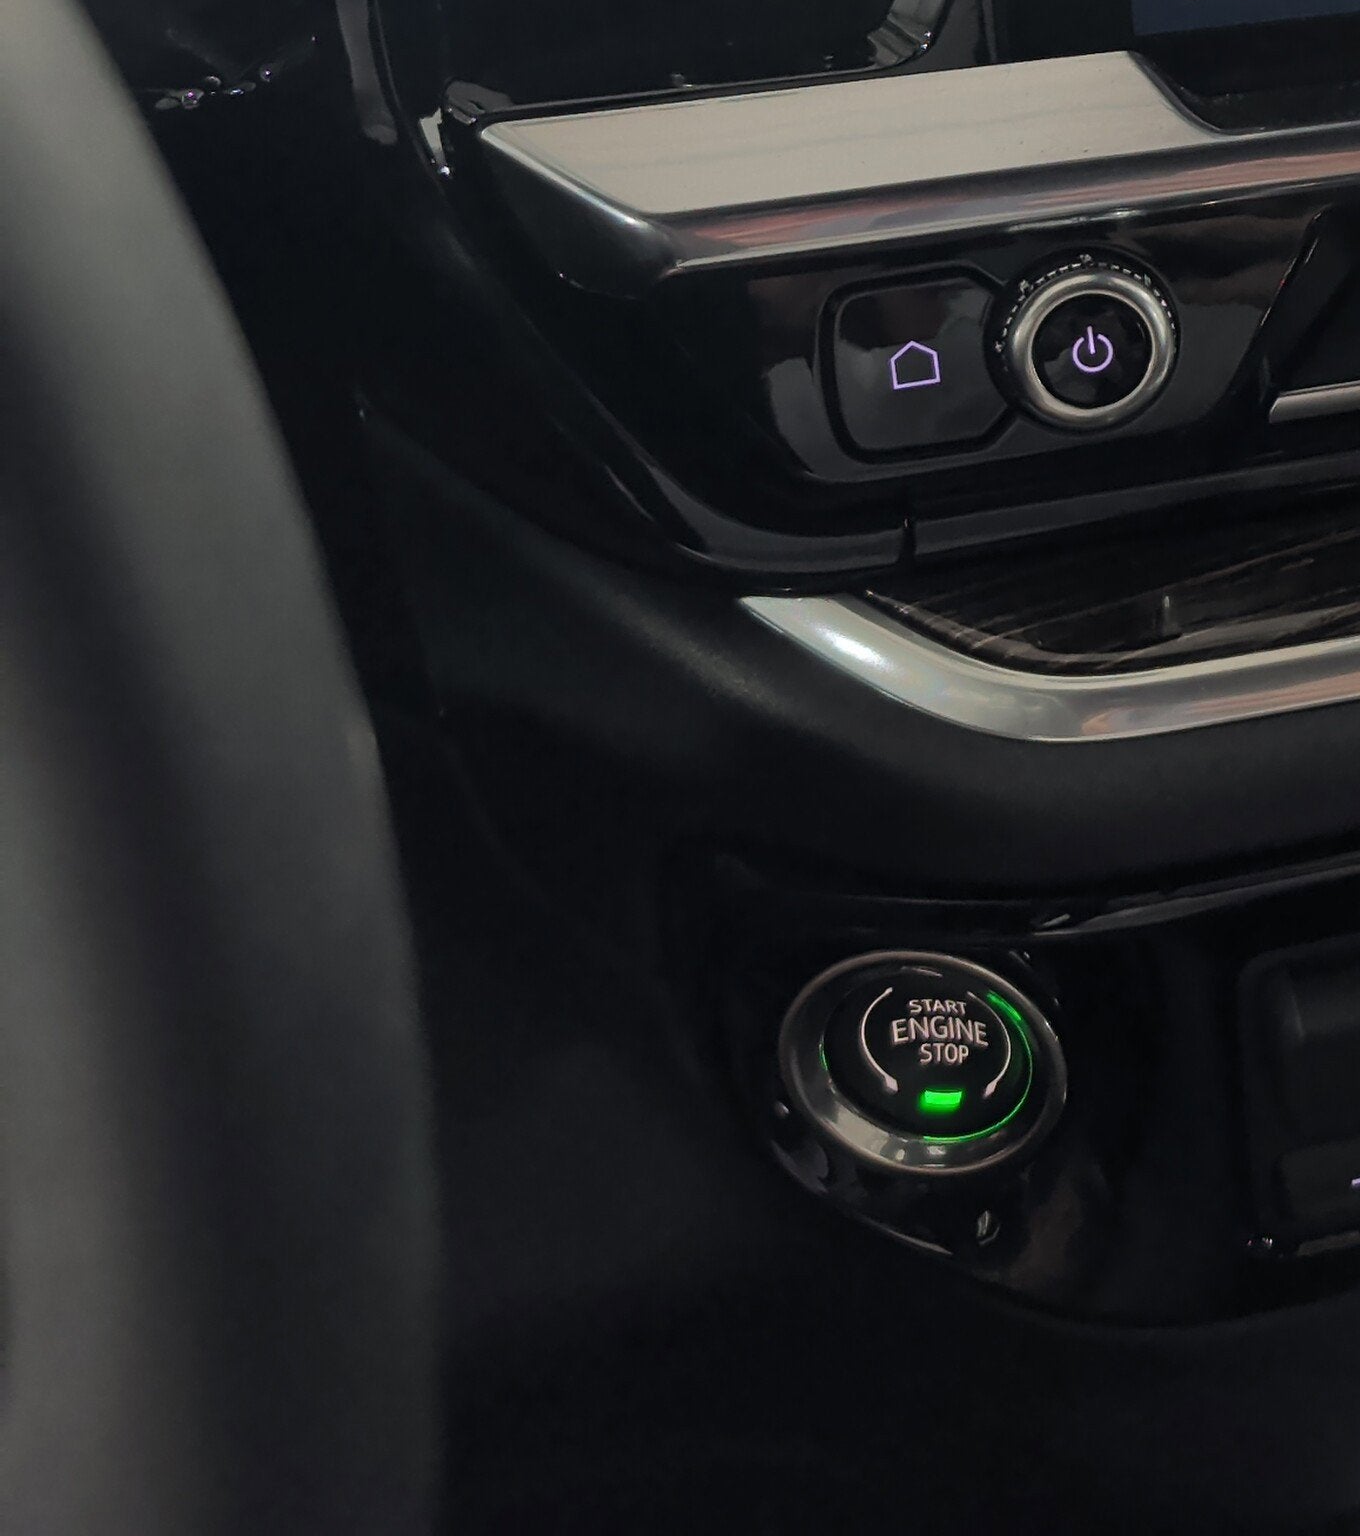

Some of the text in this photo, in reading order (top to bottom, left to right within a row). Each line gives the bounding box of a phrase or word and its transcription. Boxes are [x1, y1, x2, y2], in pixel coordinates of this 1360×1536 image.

[909, 998, 967, 1015] START
[891, 1015, 989, 1047] ENGINE
[919, 1042, 969, 1064] STOP
